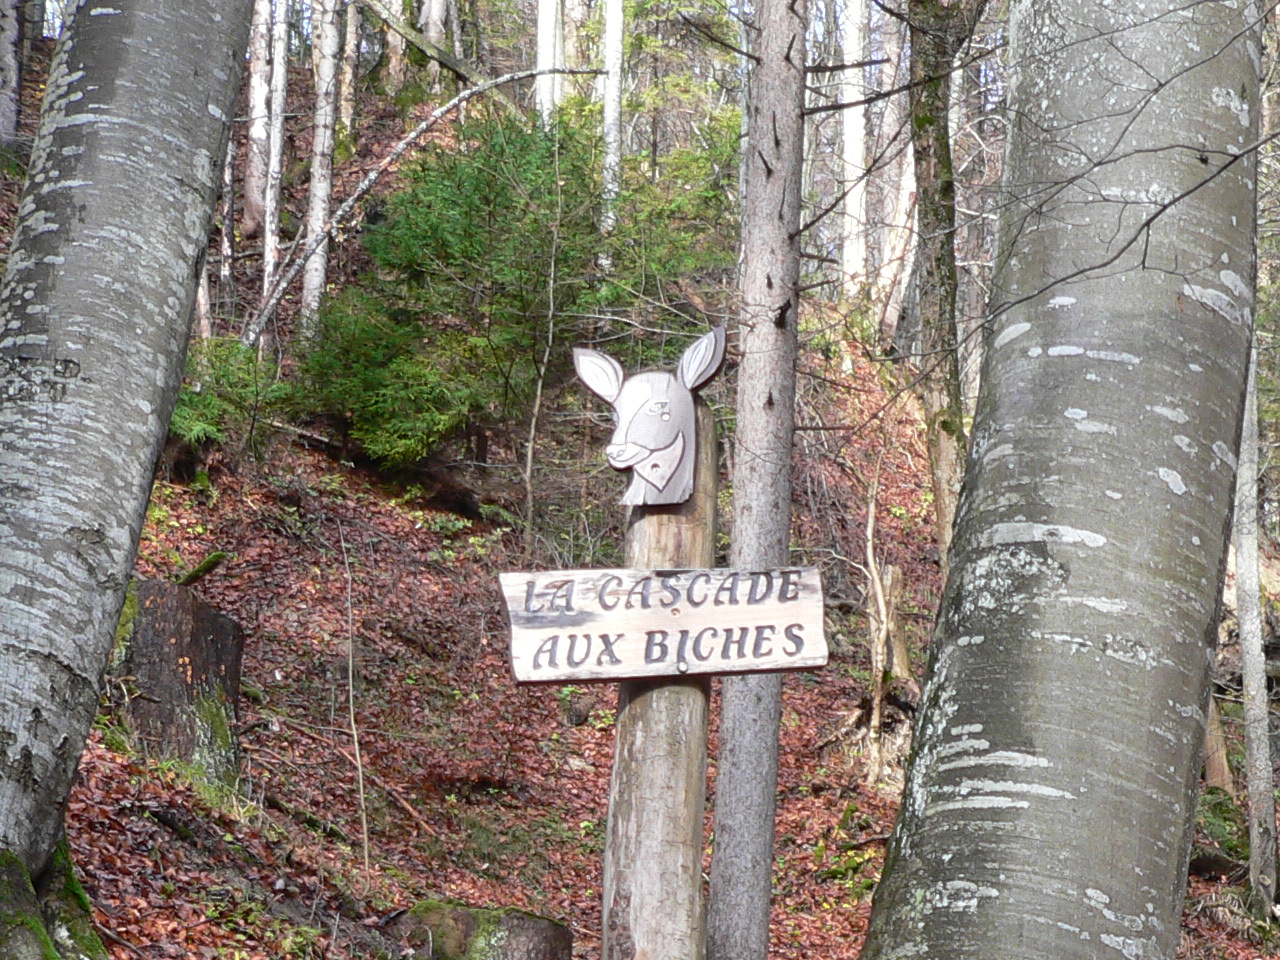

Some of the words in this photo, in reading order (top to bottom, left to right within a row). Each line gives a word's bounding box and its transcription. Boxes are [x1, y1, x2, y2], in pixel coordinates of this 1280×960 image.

[525, 579, 575, 612] LA
[598, 570, 802, 610] CASCADE
[532, 633, 625, 670] AUX
[645, 623, 805, 665] BICHES
